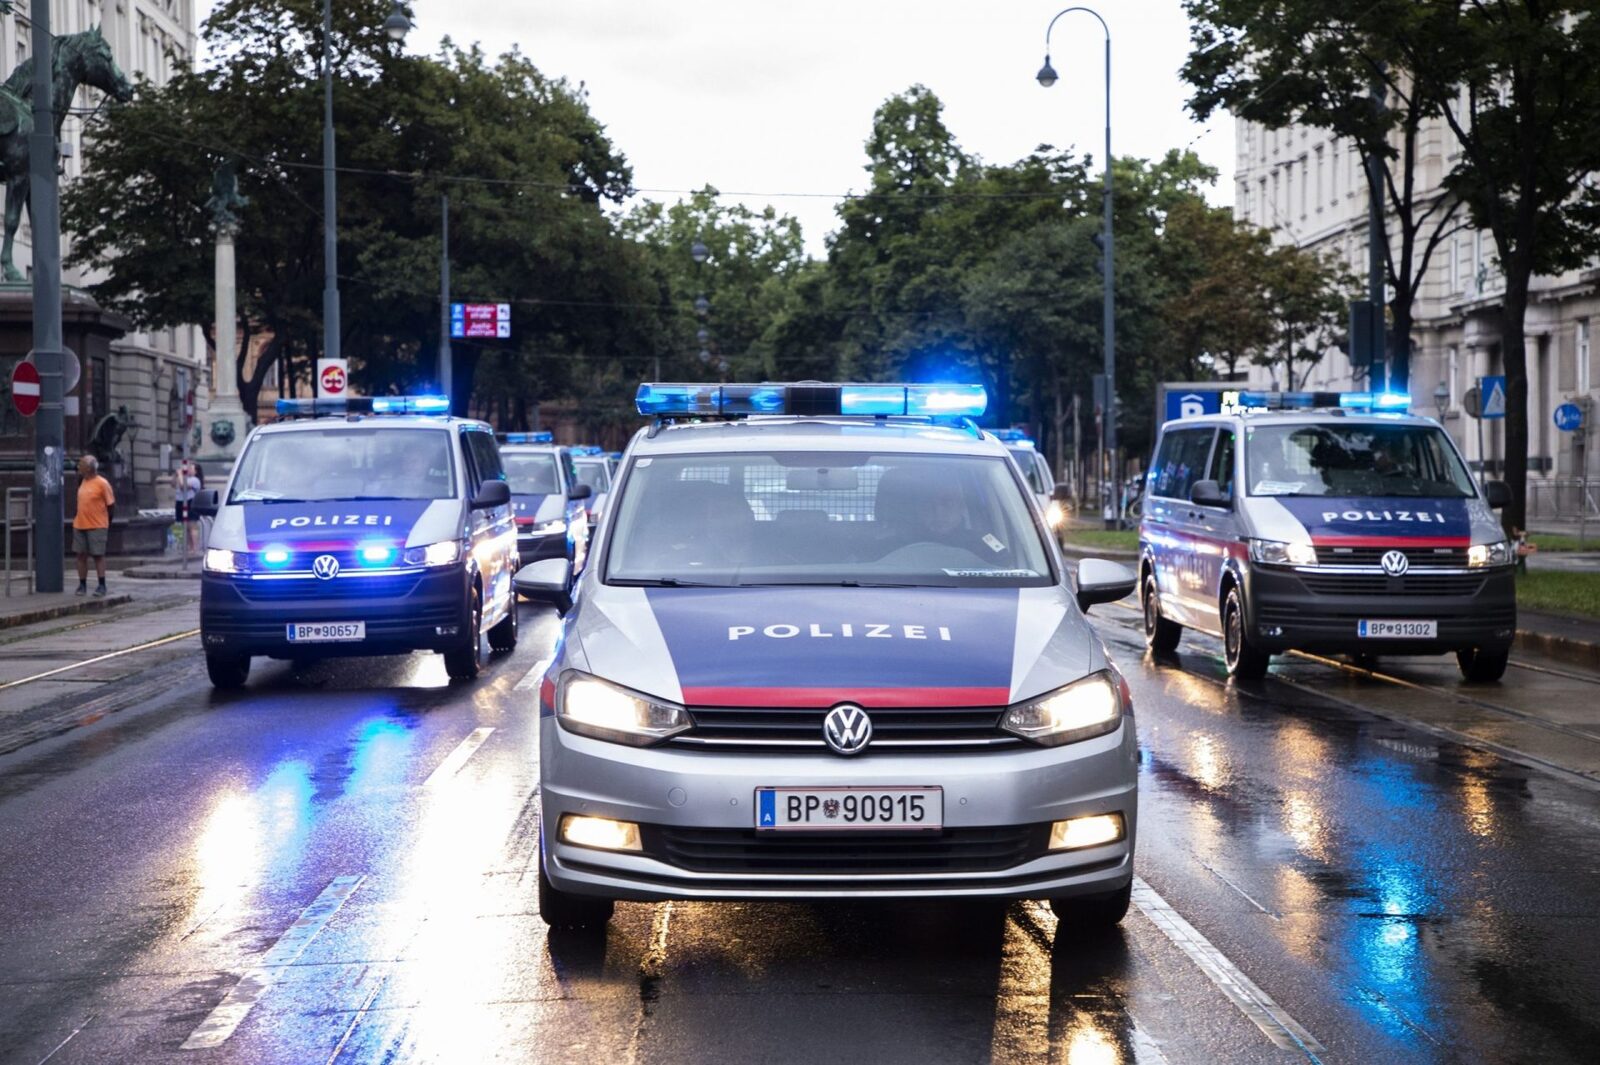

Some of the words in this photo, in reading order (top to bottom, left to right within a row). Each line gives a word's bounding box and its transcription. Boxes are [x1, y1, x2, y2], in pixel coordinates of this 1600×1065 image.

[270, 514, 392, 529] POLIZEI
[1322, 510, 1446, 523] POLIZEI
[299, 626, 313, 638] BP
[322, 624, 359, 637] 90657
[728, 623, 952, 641] POLIZEI
[1371, 623, 1385, 634] BP
[1394, 623, 1431, 635] 91302
[825, 705, 871, 753] VW
[787, 795, 820, 823] BP
[843, 795, 925, 823] 90915
[763, 813, 772, 822] A
